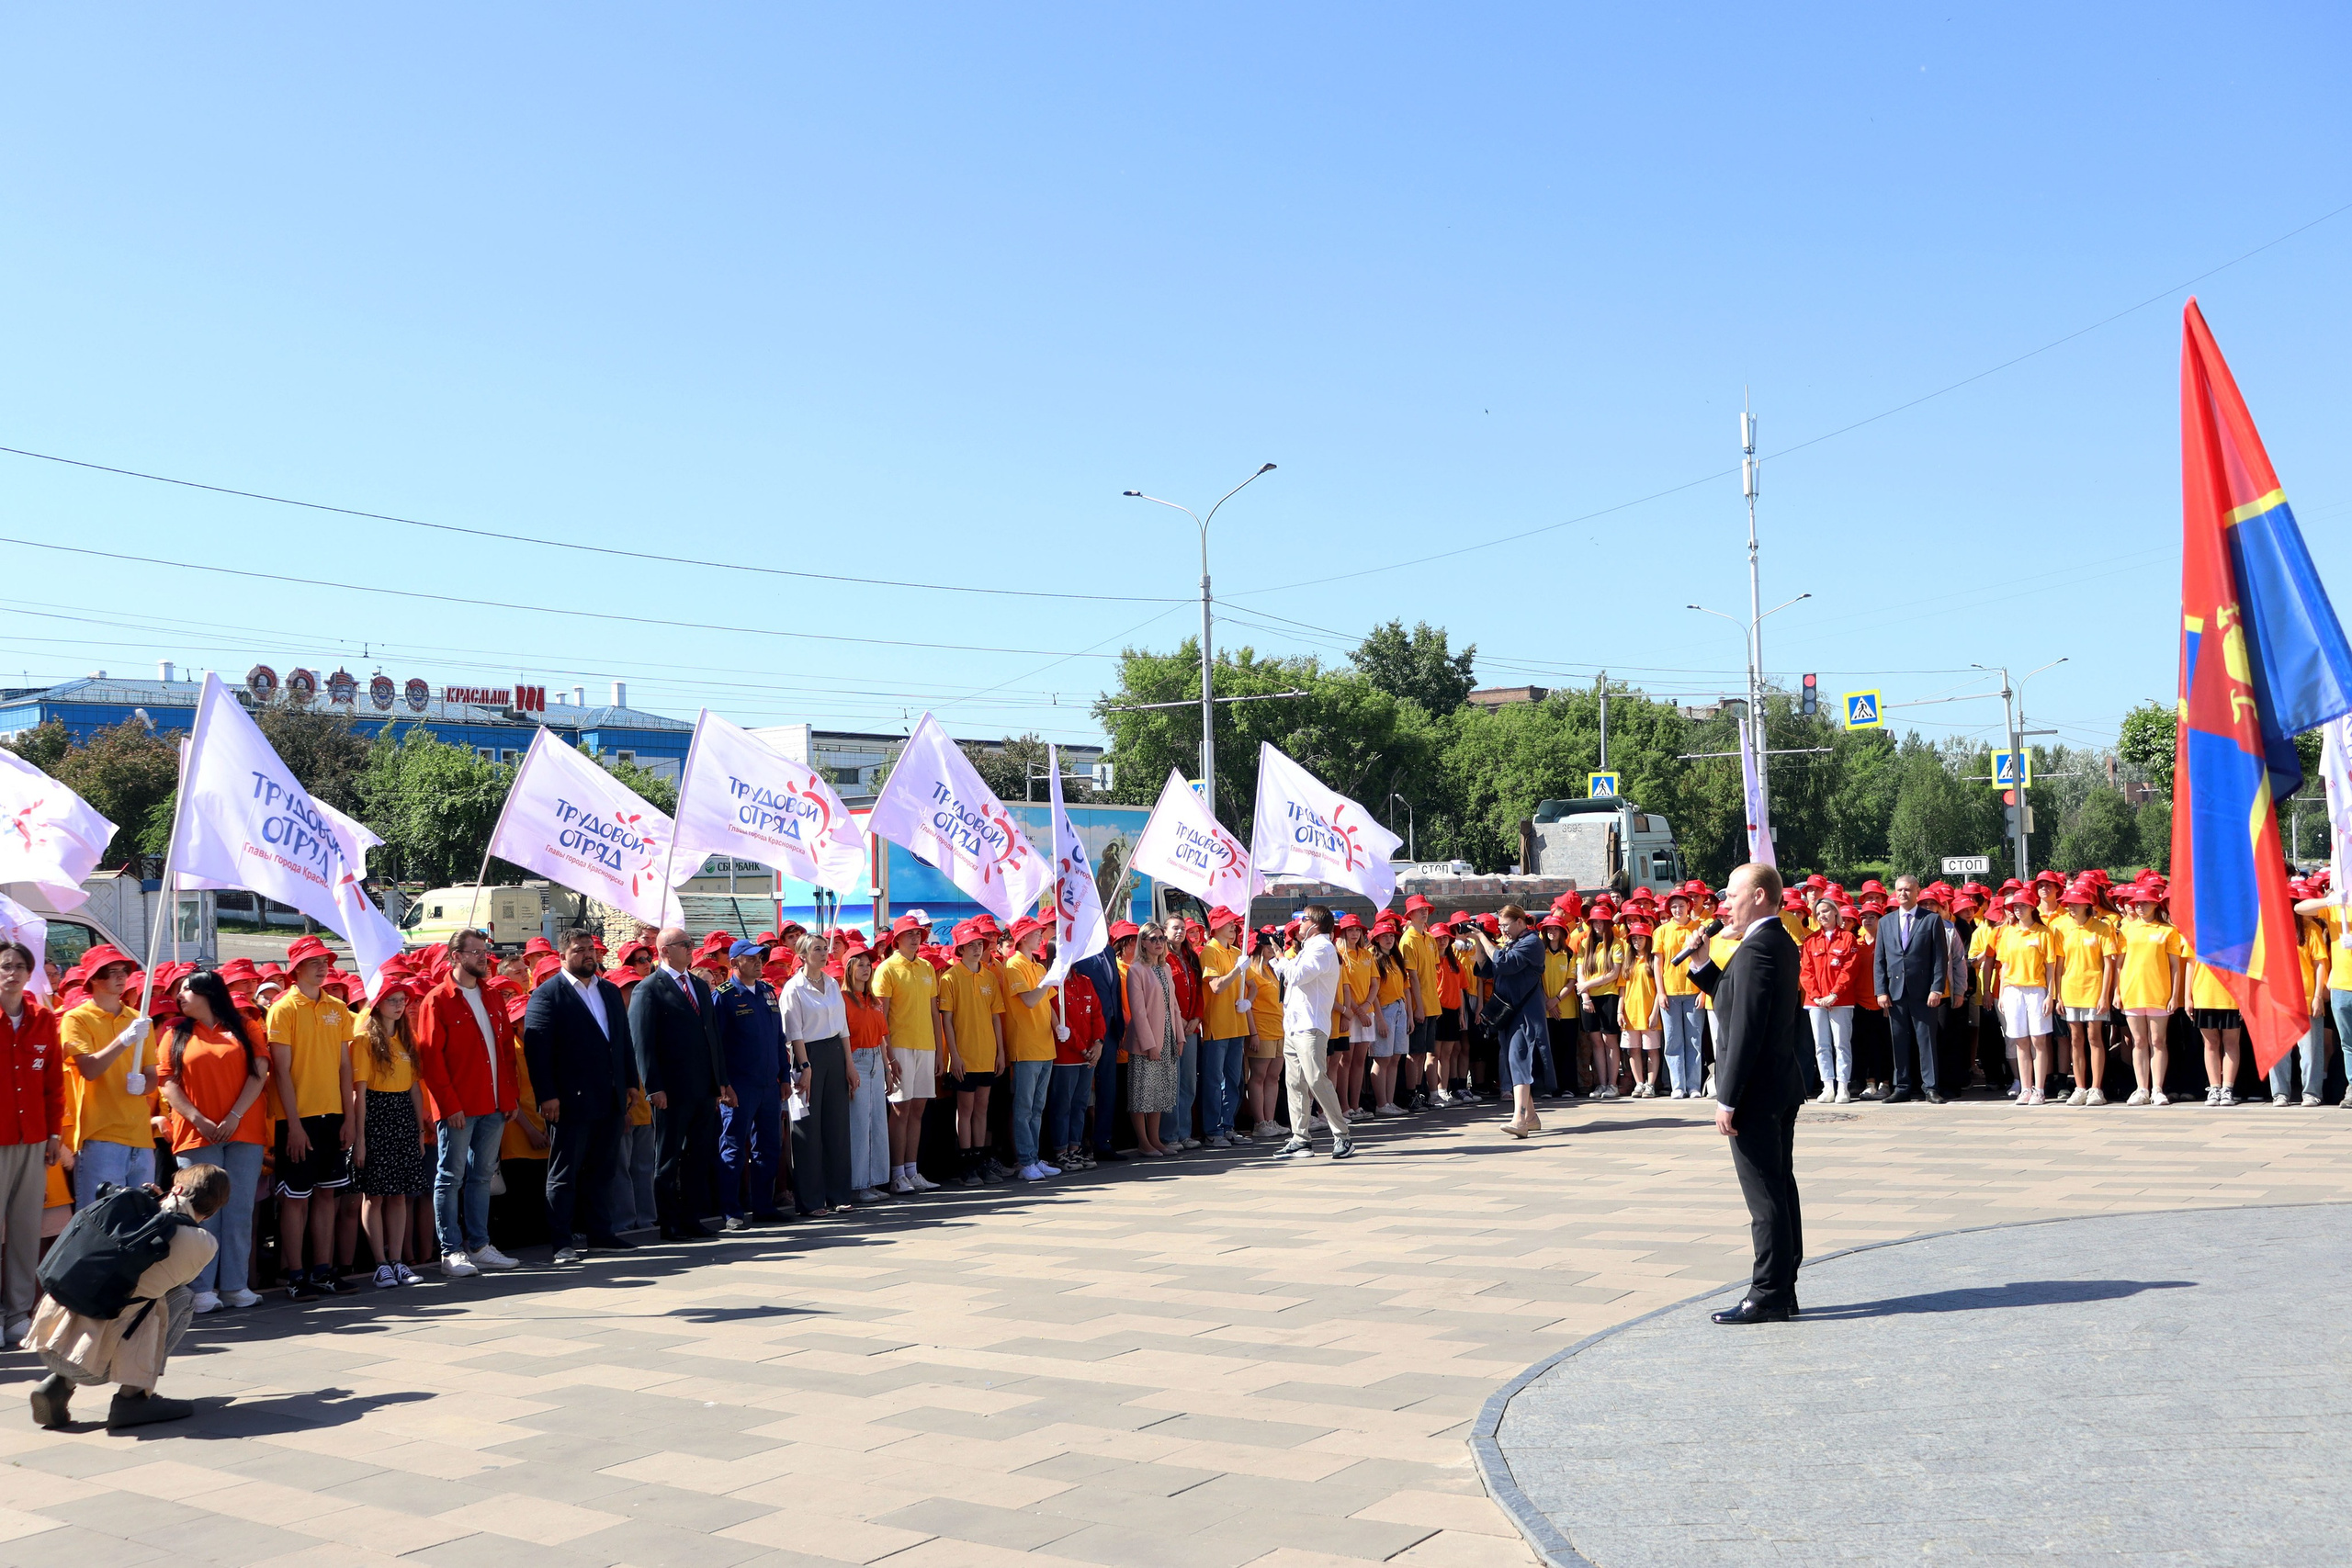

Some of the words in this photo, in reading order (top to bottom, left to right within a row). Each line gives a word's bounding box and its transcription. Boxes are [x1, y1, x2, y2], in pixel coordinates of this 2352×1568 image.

[447, 687, 510, 705] КРАСМАШ
[729, 776, 818, 822] ТРУДОВОЙ
[556, 798, 645, 854] ТРУДОВОЙ
[739, 805, 801, 840] ОТРЯД
[560, 829, 622, 871] ОТРЯД
[767, 836, 806, 855] Красноярска
[935, 834, 954, 852] города
[1176, 821, 1230, 859] ТРУДОВОЙ
[243, 842, 274, 861] Главы
[273, 854, 302, 874] города
[545, 844, 565, 858] Главы
[565, 853, 587, 868] города
[587, 862, 625, 886] Красноярска
[1176, 843, 1209, 869] ОТРЯД
[1421, 864, 1449, 874] СТОП
[1949, 859, 1983, 871] СТОП
[31, 1057, 45, 1069] 20
